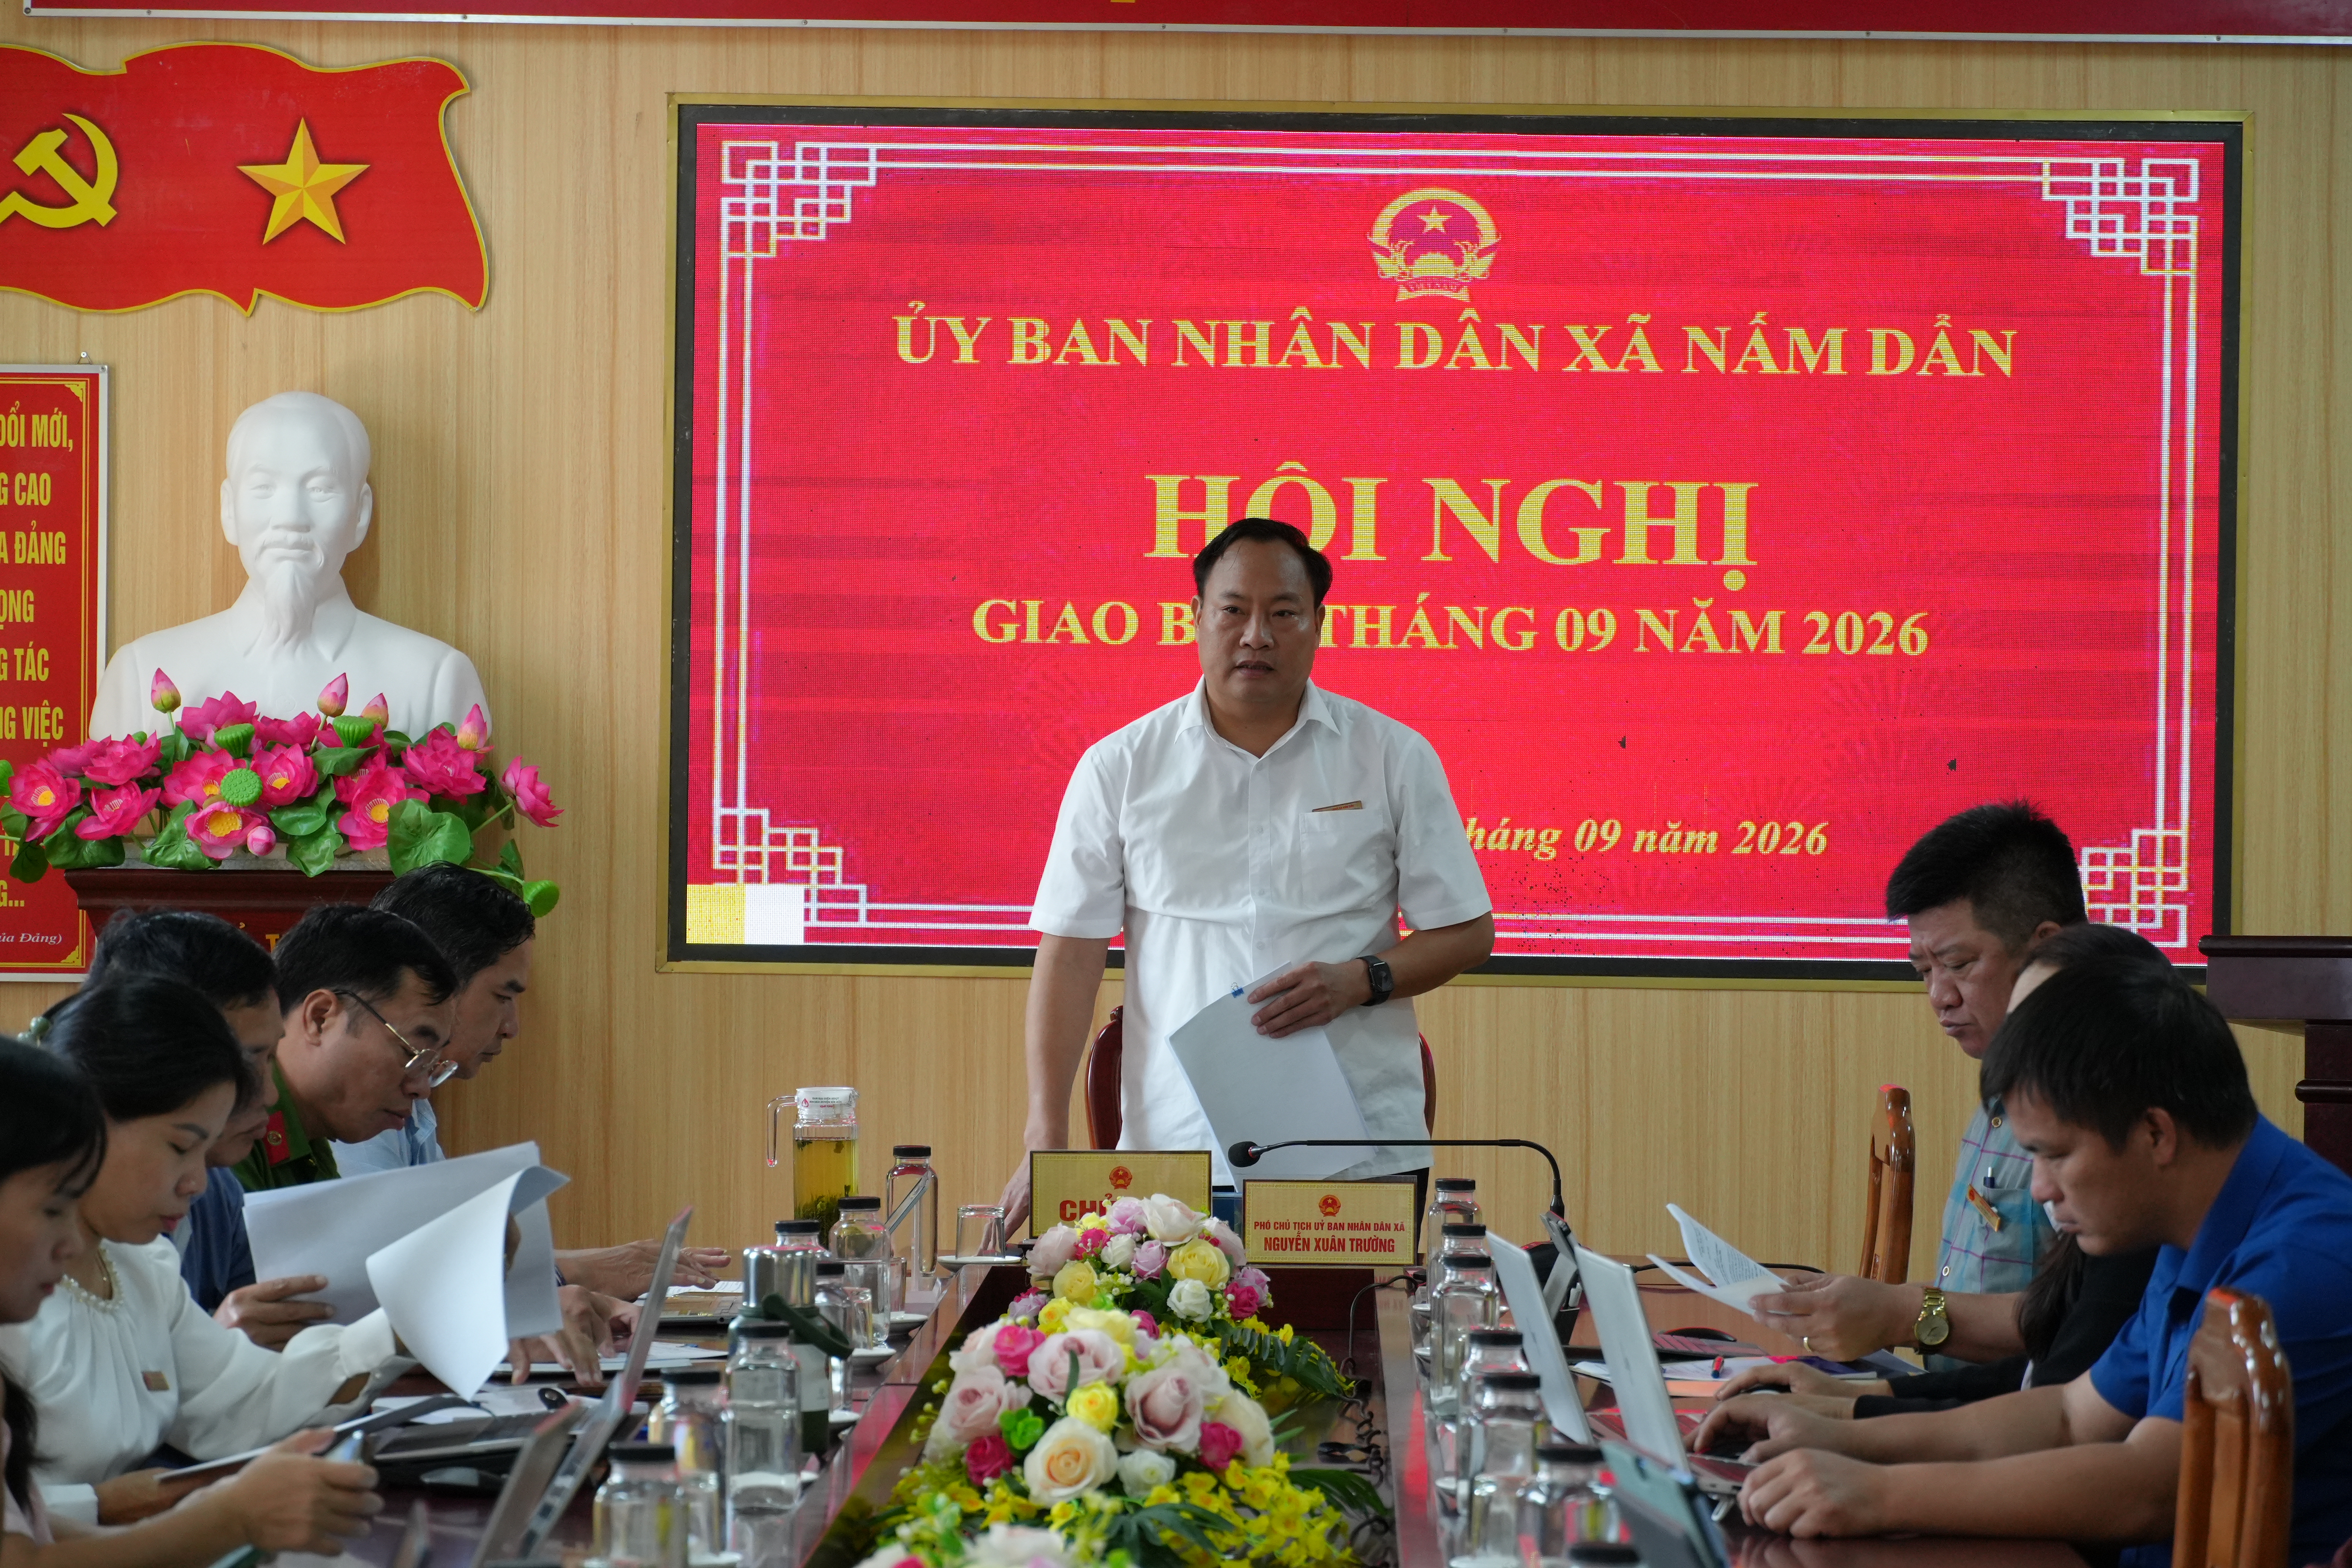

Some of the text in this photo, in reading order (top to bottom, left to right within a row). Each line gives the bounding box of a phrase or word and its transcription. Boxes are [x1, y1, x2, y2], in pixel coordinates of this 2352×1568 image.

[892, 301, 2018, 377] ỦY BAN NHÂN DÂN XÃ NẤM DẪN
[32, 407, 73, 452] MỚI,
[14, 473, 51, 506] CAO
[14, 520, 66, 565] ĐẢNG
[1421, 478, 1759, 591] NGHỊ
[972, 599, 1139, 645] GIAO
[1318, 592, 1538, 651] THÁNG
[1555, 608, 1617, 652] 09
[1634, 597, 1786, 654] NĂM
[1802, 611, 1929, 656] 2026
[14, 641, 49, 681] TÁC
[22, 700, 63, 747] VIỆC
[1466, 817, 1829, 860] háng 09 năm 2026
[19, 933, 62, 945] Đảng)
[1254, 1219, 1405, 1231] PHÓ CHỦ TỊCH UỶ BAN NHÂN DÂN XÃ
[1264, 1231, 1395, 1253] NGUYỄN XUÂN TRƯỜNG
